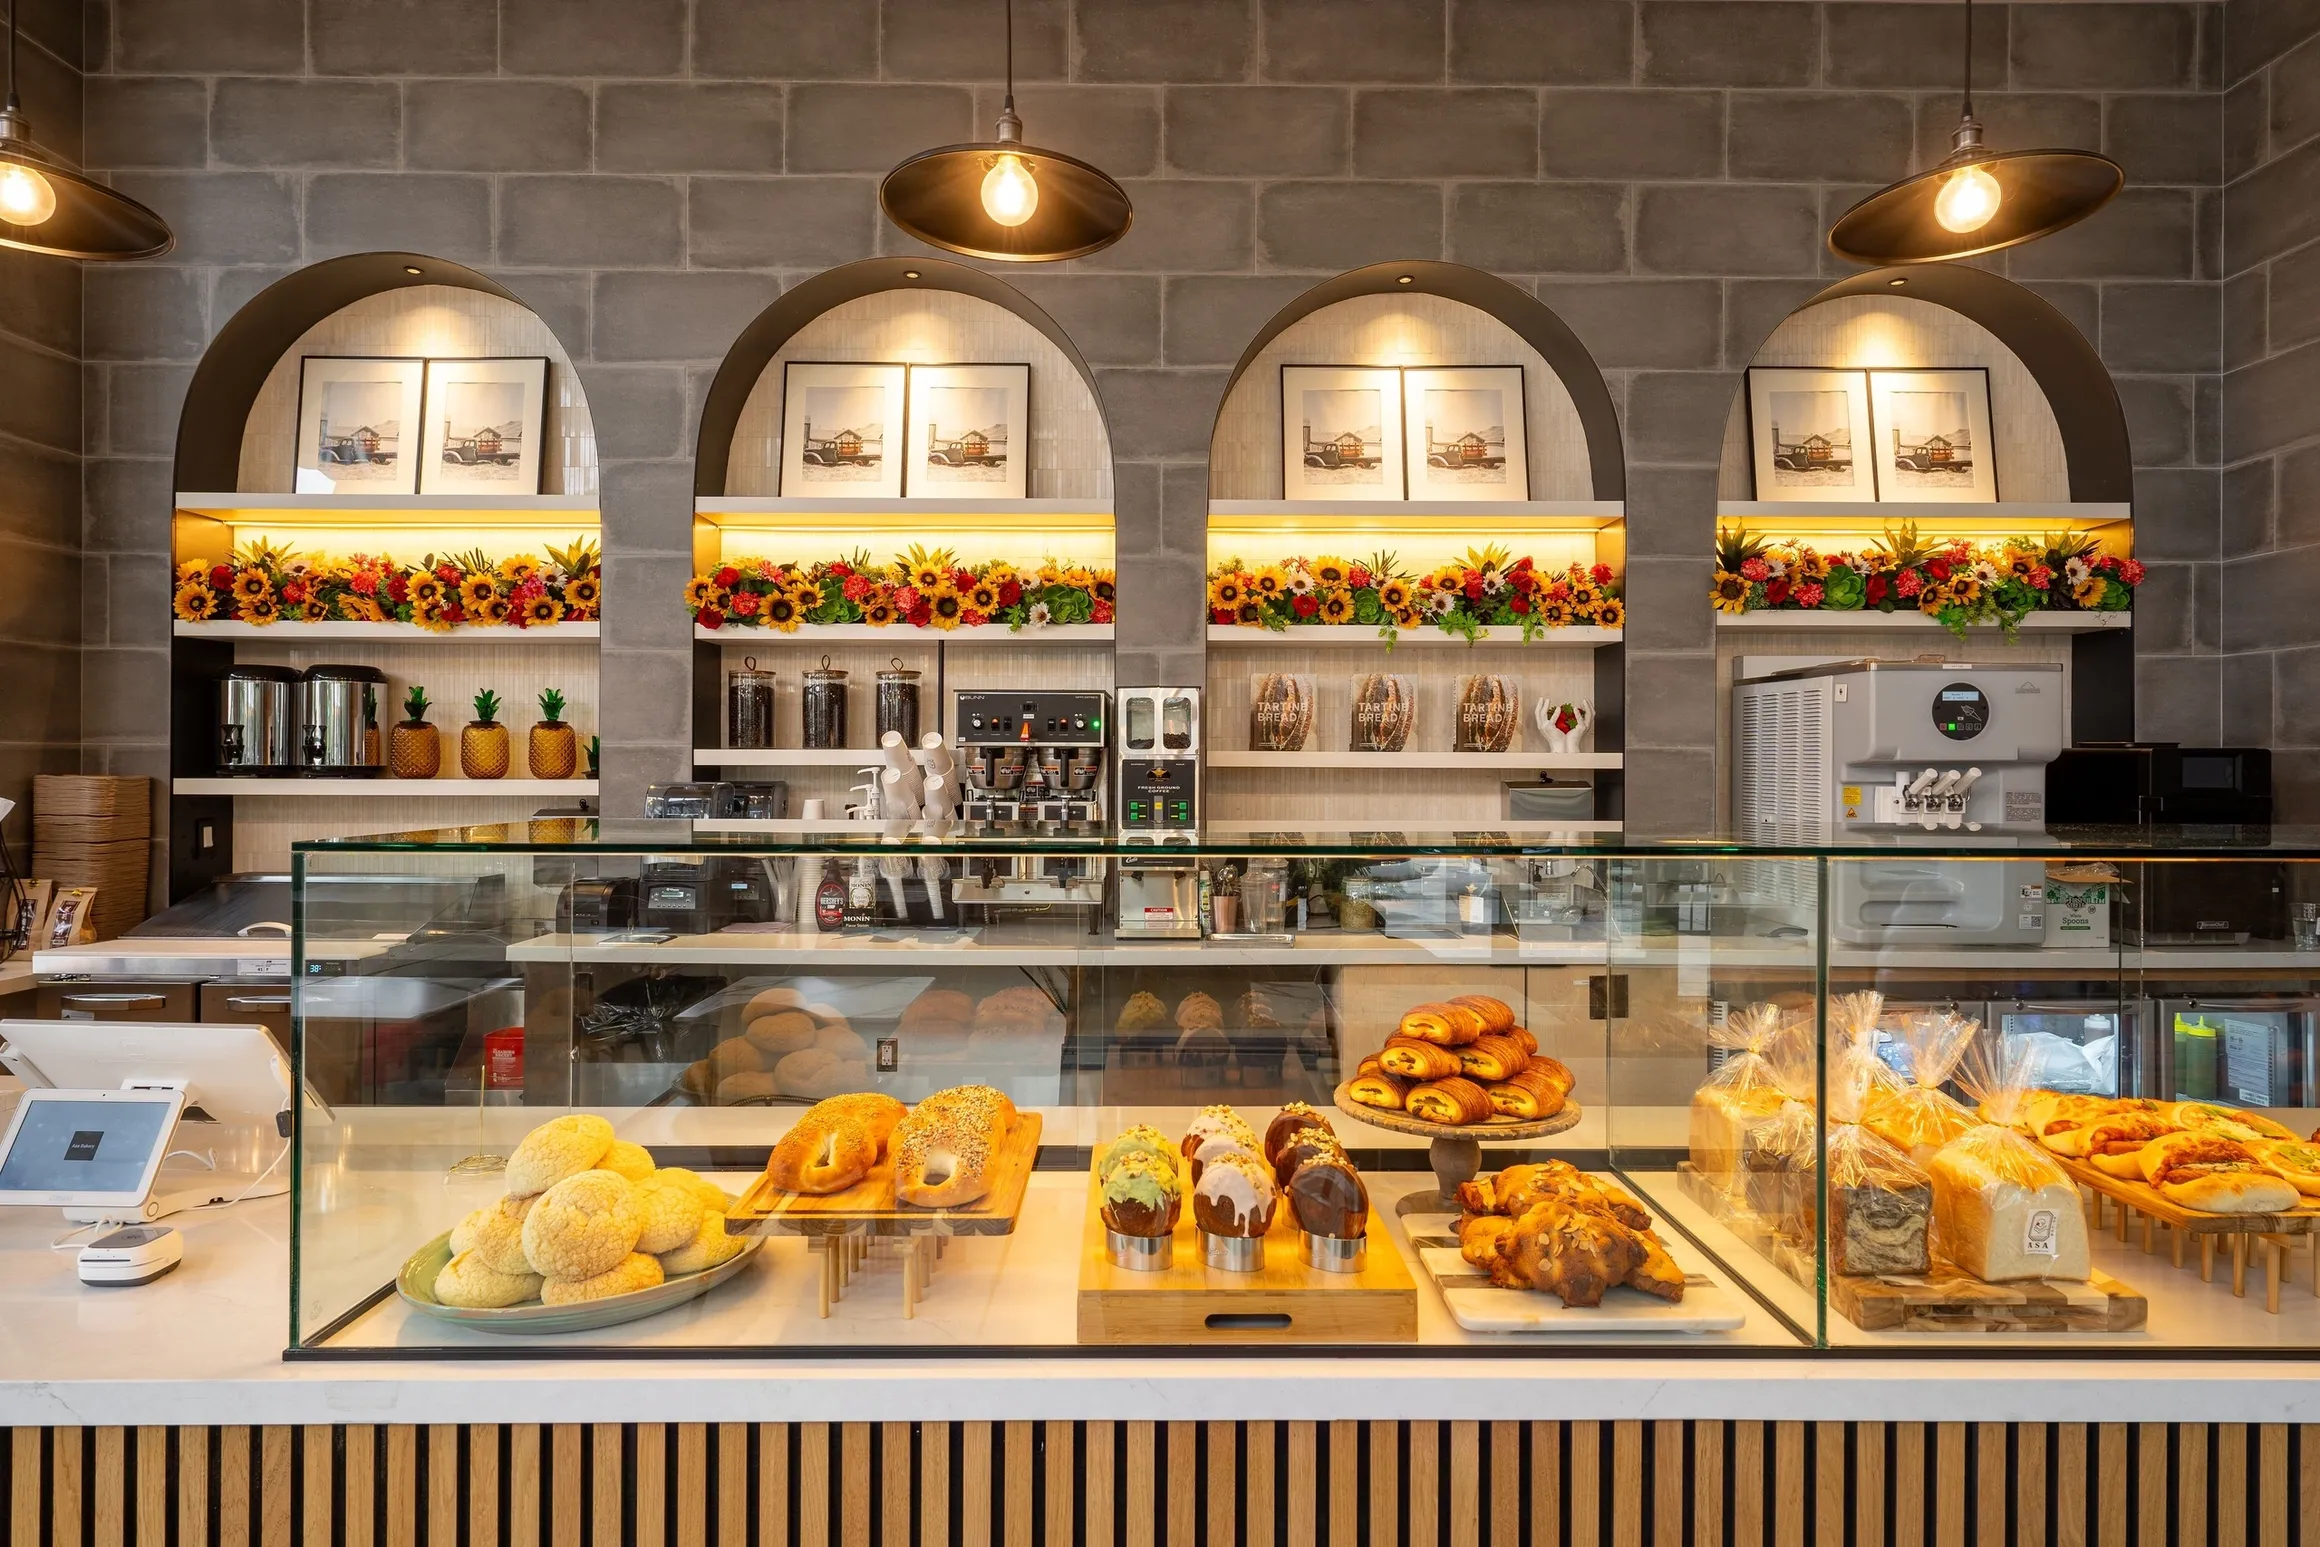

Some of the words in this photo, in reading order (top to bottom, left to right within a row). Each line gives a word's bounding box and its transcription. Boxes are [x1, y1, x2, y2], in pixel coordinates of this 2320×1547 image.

[1257, 702, 1308, 712] TARTINE
[1358, 702, 1408, 712] TARTINE
[1463, 703, 1512, 712] TARTINE
[1257, 713, 1297, 721] BREAD
[1358, 713, 1398, 722] BREAD
[1463, 713, 1503, 722] BREAD
[2062, 917, 2089, 925] Spoons
